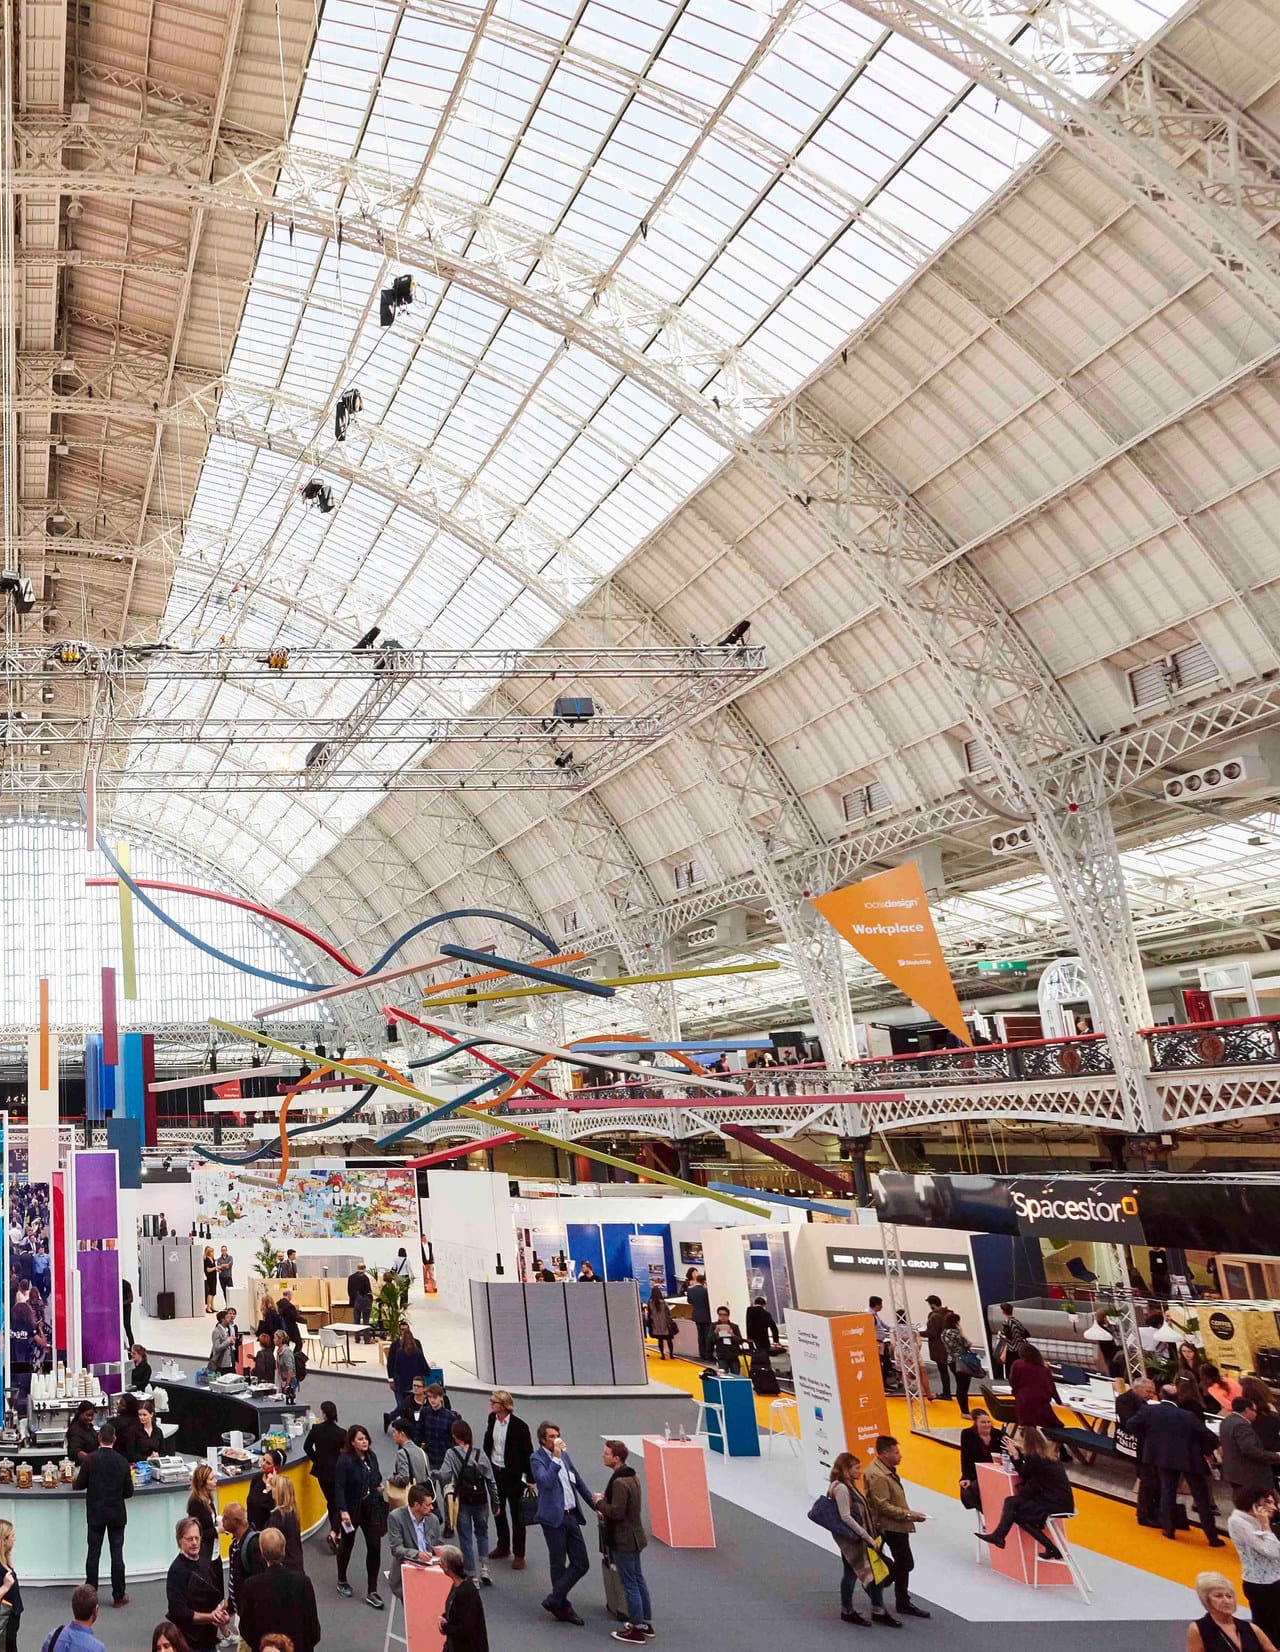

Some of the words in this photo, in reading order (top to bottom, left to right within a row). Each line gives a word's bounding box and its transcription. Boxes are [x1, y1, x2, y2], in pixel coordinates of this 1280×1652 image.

[852, 922, 924, 936] Workplace
[16, 1153, 29, 1161] Exi
[887, 1258, 907, 1267] STL
[907, 1259, 939, 1269] GROUP
